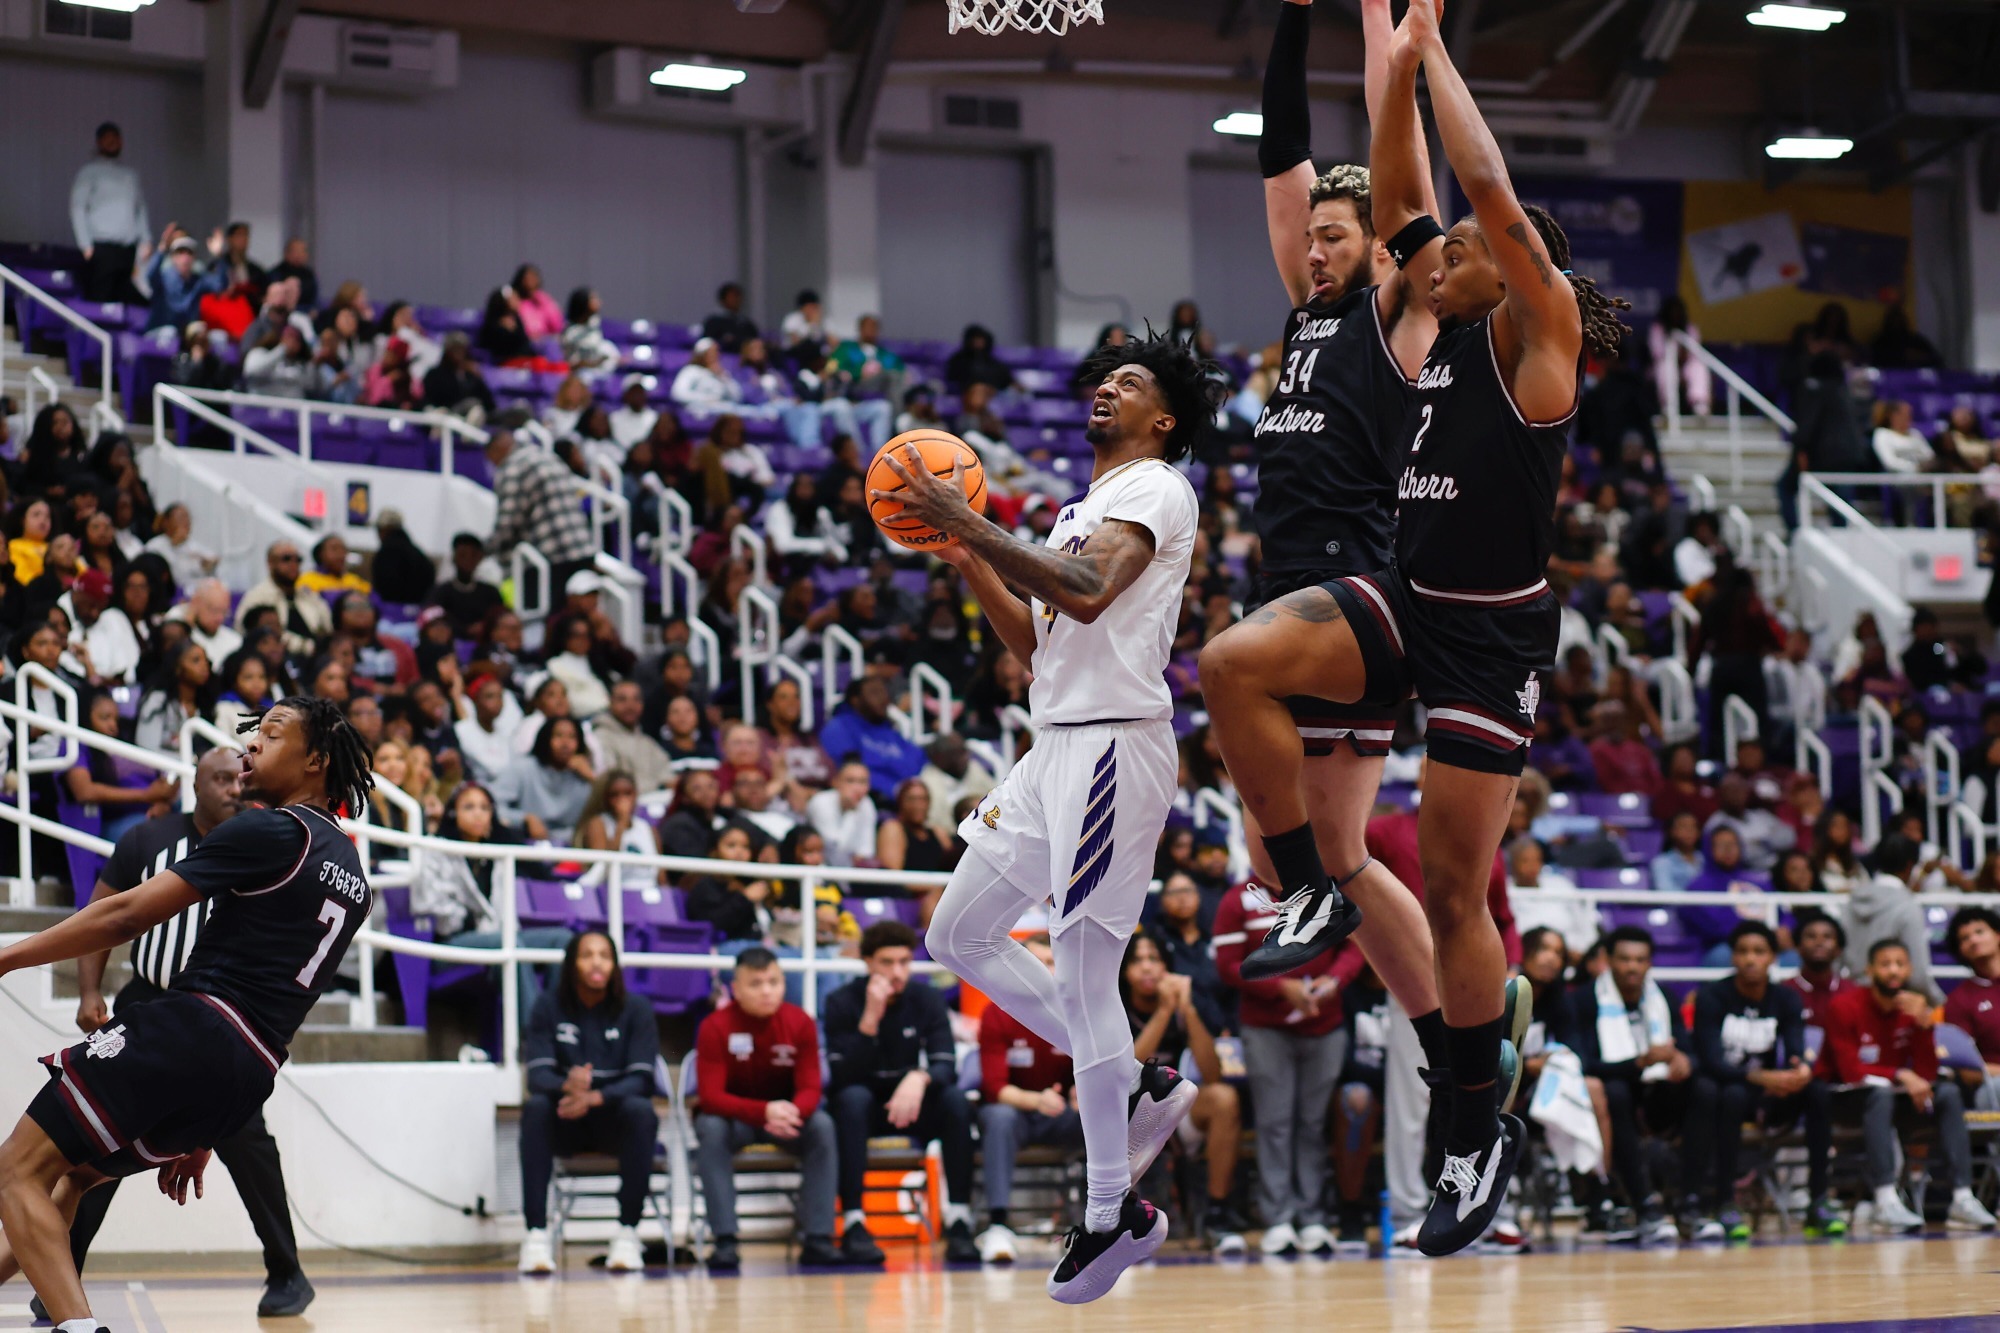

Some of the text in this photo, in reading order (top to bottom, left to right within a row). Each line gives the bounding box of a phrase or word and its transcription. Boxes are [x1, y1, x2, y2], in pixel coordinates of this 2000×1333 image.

[1291, 312, 1341, 341] Texas
[1279, 349, 1320, 394] 34
[1253, 403, 1326, 438] Southern
[1411, 404, 1433, 452] 2
[319, 860, 366, 904] TIGERS
[295, 898, 347, 989] 7
